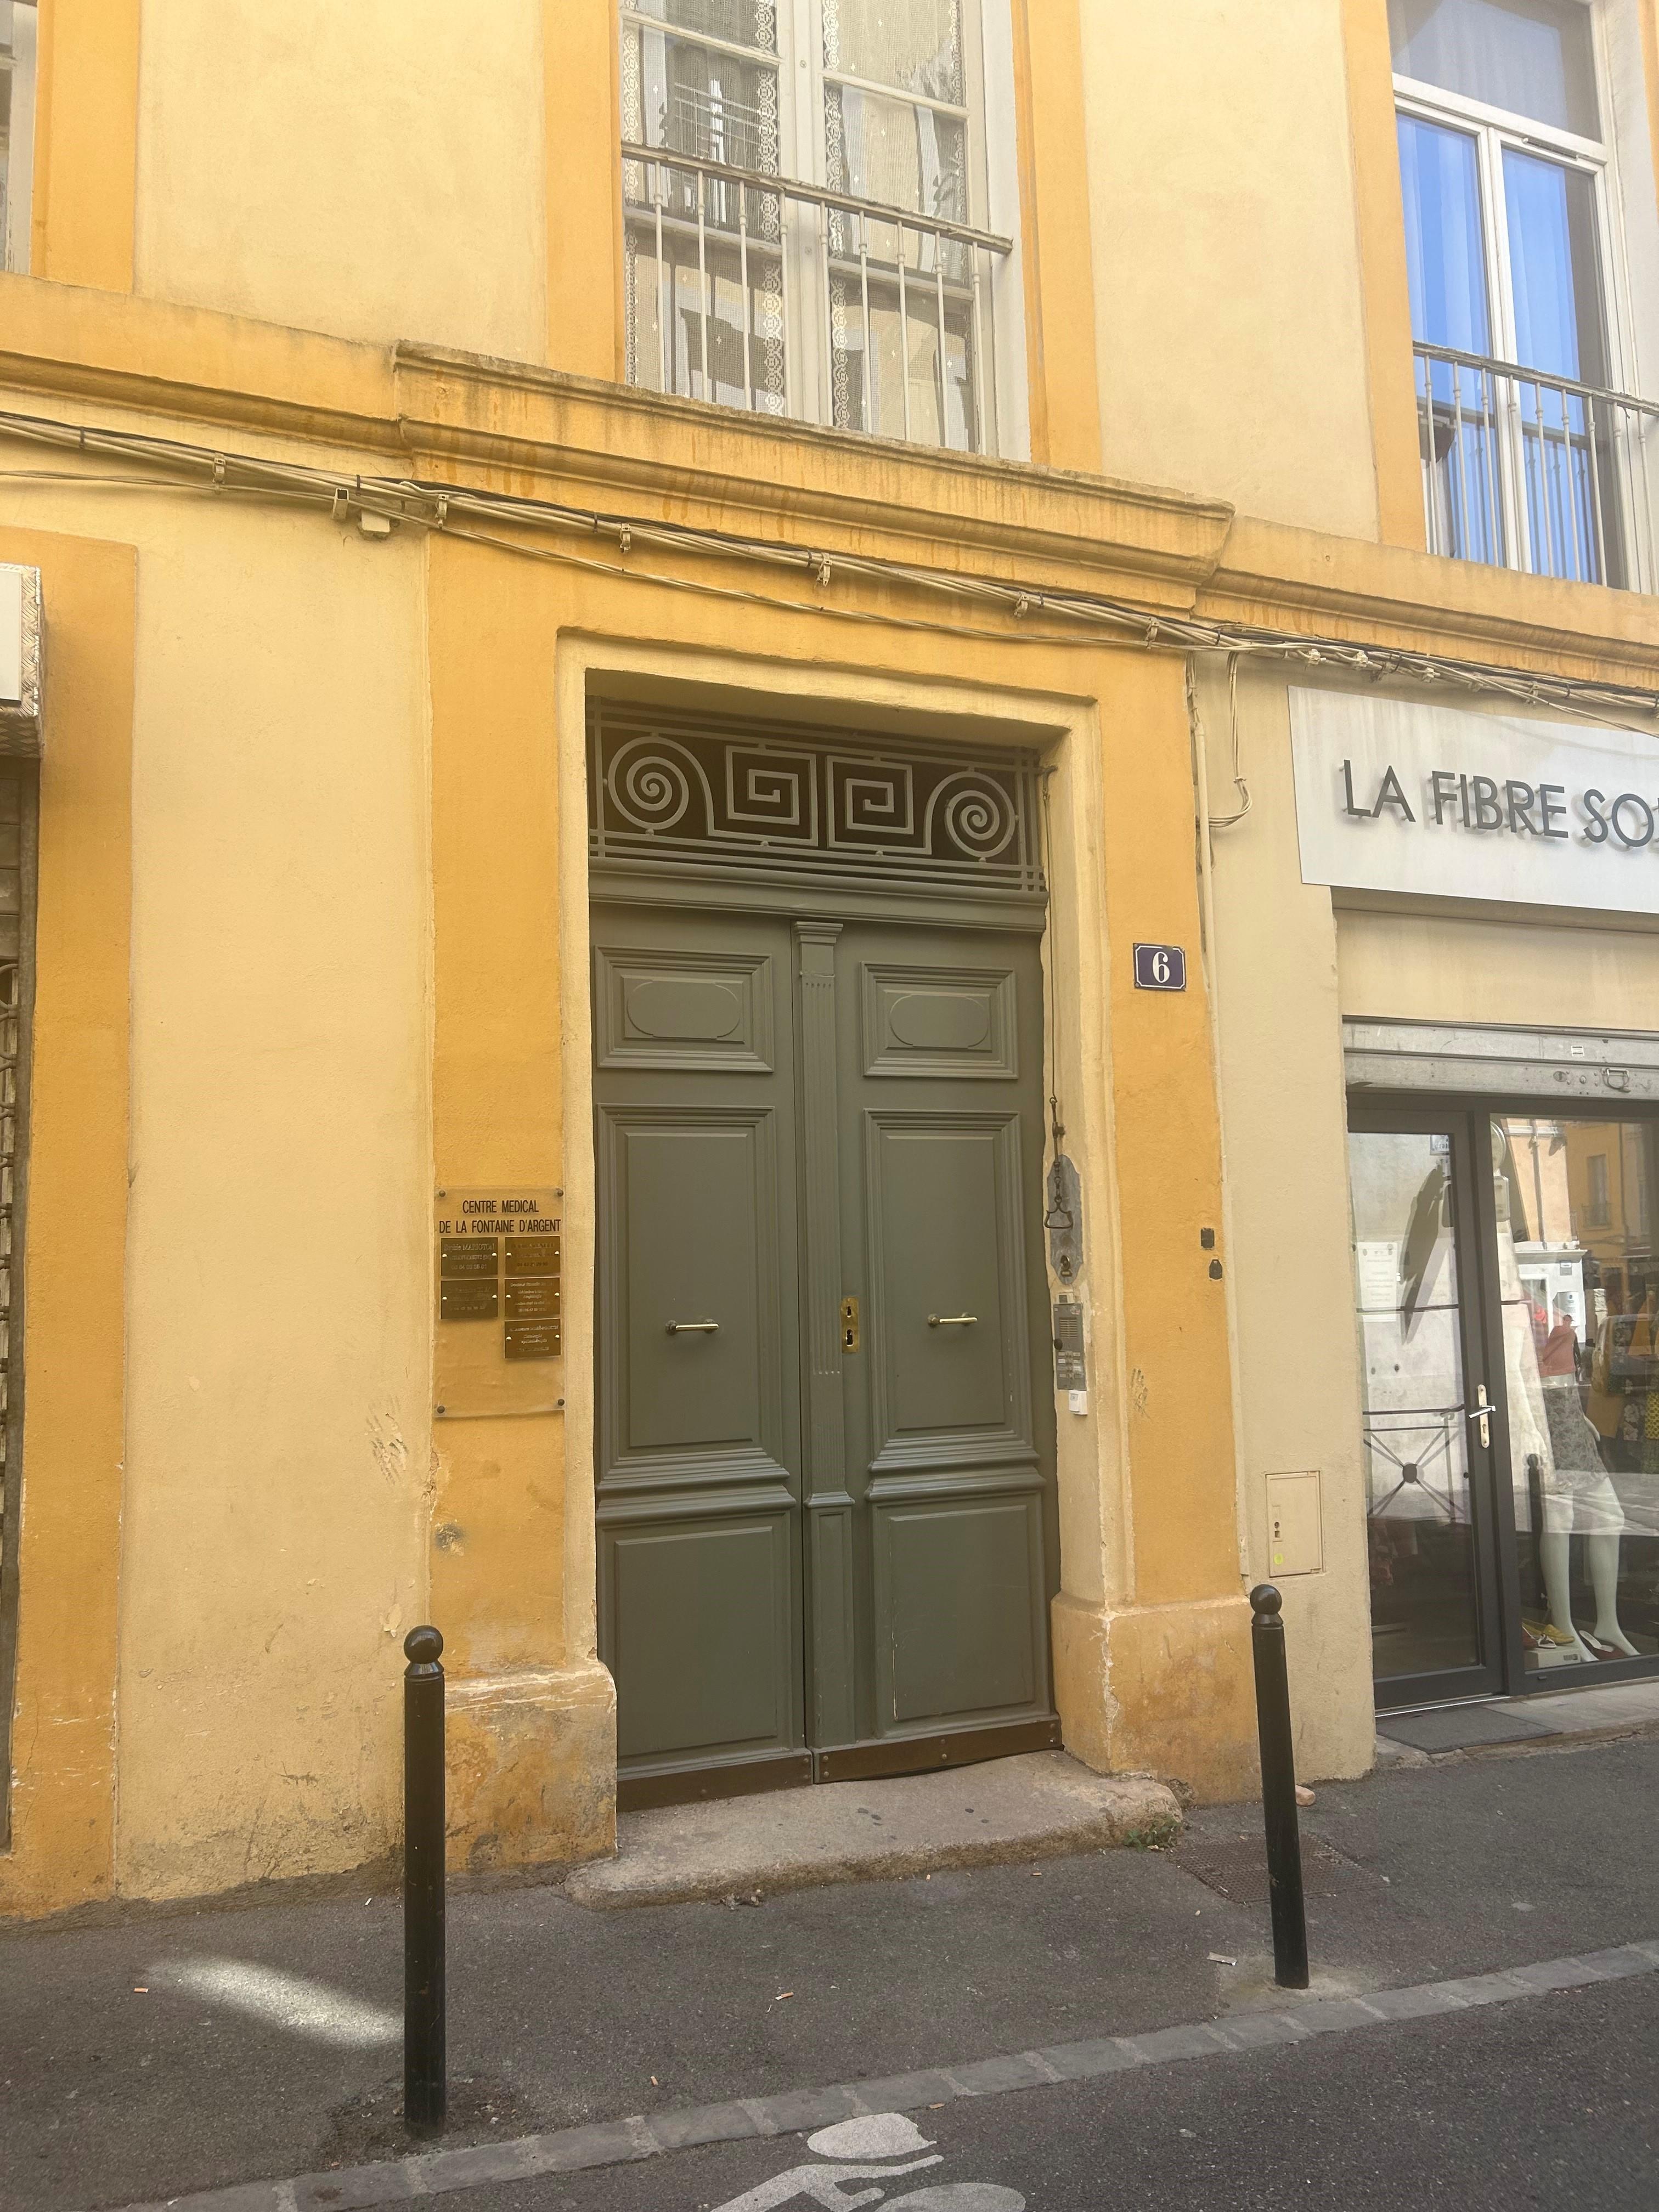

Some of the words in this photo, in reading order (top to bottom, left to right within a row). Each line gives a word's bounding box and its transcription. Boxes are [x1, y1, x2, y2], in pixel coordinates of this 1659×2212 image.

[1344, 759, 1416, 822] LA
[1431, 770, 1569, 839] FIBRE
[1583, 788, 1659, 848] SO
[1152, 951, 1170, 983] 6
[462, 1200, 497, 1214] CENTRE
[501, 1199, 539, 1213] MEDICAL
[439, 1220, 451, 1233] DE
[456, 1220, 467, 1233] LA
[472, 1219, 515, 1233] FONTAINE
[519, 1218, 561, 1232] D'ARGENT
